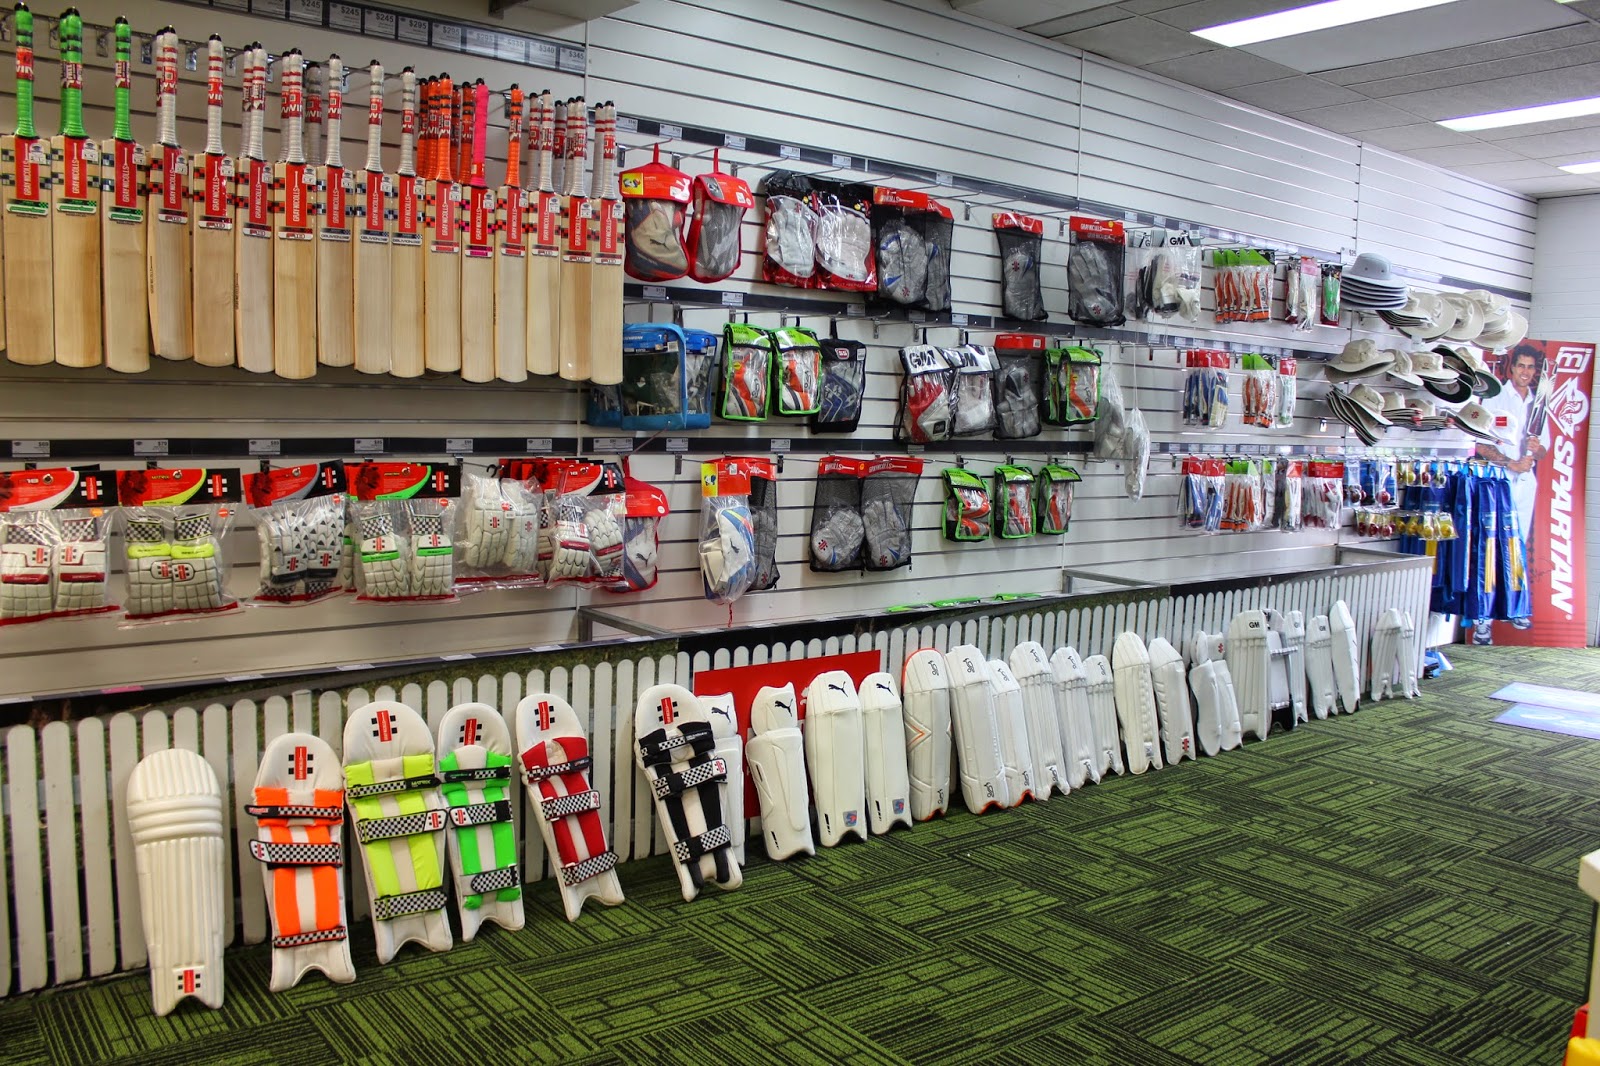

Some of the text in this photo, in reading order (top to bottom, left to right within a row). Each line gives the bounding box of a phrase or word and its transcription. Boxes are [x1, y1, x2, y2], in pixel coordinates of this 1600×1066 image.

[341, 6, 360, 16] $245
[376, 13, 394, 23] $245
[409, 20, 427, 29] $295
[443, 26, 461, 35] $295
[1170, 236, 1186, 246] GM
[909, 350, 936, 368] GM
[1550, 437, 1576, 614] SPARTAN
